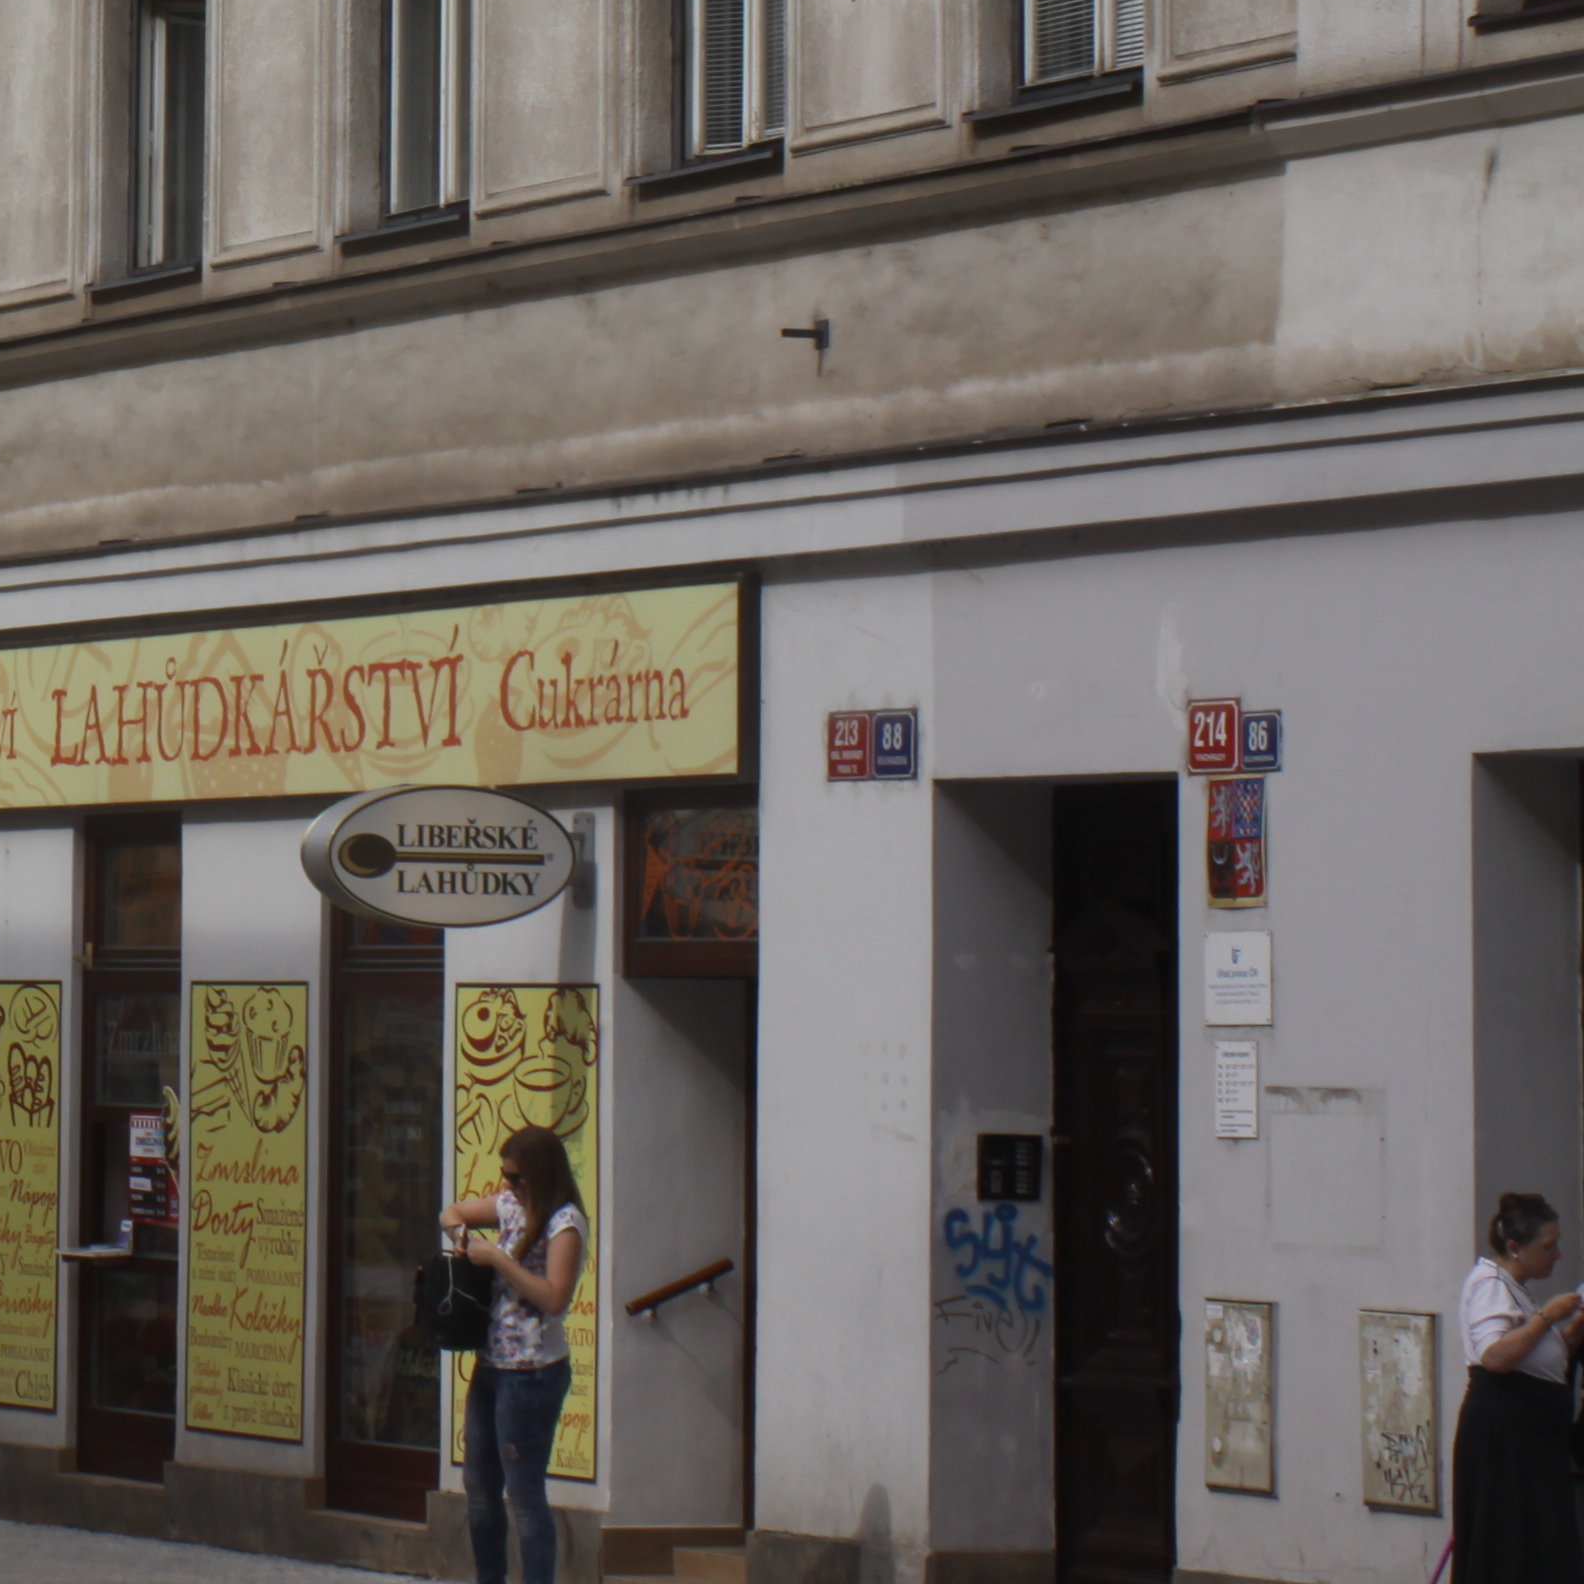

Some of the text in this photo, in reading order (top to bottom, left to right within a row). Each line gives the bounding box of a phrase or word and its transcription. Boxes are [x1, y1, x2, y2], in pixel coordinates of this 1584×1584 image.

[50, 624, 465, 768] LAHŮDKÁŘSTVÍ
[499, 639, 691, 732] Cukrárna
[834, 719, 859, 747] 213
[882, 722, 903, 750] 88
[1194, 711, 1227, 747] 214
[1248, 720, 1268, 752] 86
[395, 817, 539, 850] LIBEŘSKÉ
[395, 863, 542, 897] LAHŮDKY
[192, 1189, 256, 1270] Dorty
